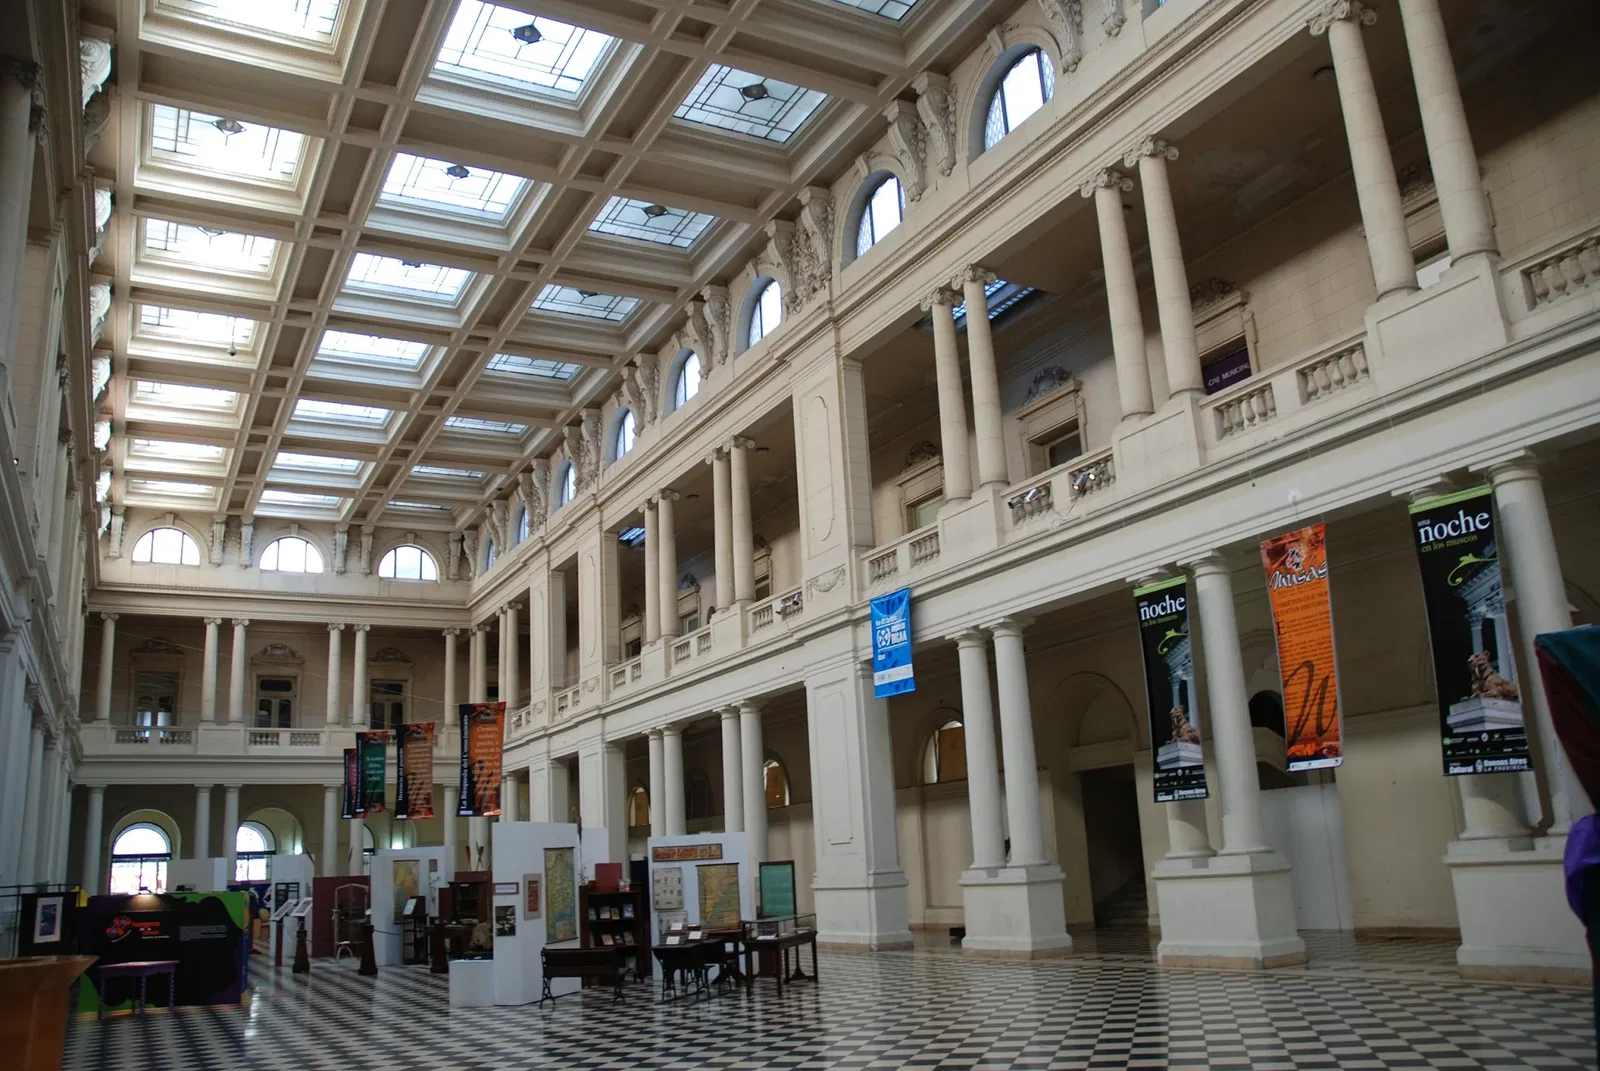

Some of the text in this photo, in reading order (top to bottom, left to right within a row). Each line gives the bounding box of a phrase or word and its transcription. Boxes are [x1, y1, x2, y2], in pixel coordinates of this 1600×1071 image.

[1222, 363, 1250, 379] MUNICIPAL
[1419, 509, 1491, 544] noche
[1140, 595, 1186, 620] noche
[461, 714, 469, 757] Conocimiento
[461, 769, 469, 799] Búsqueda
[460, 800, 467, 809] La
